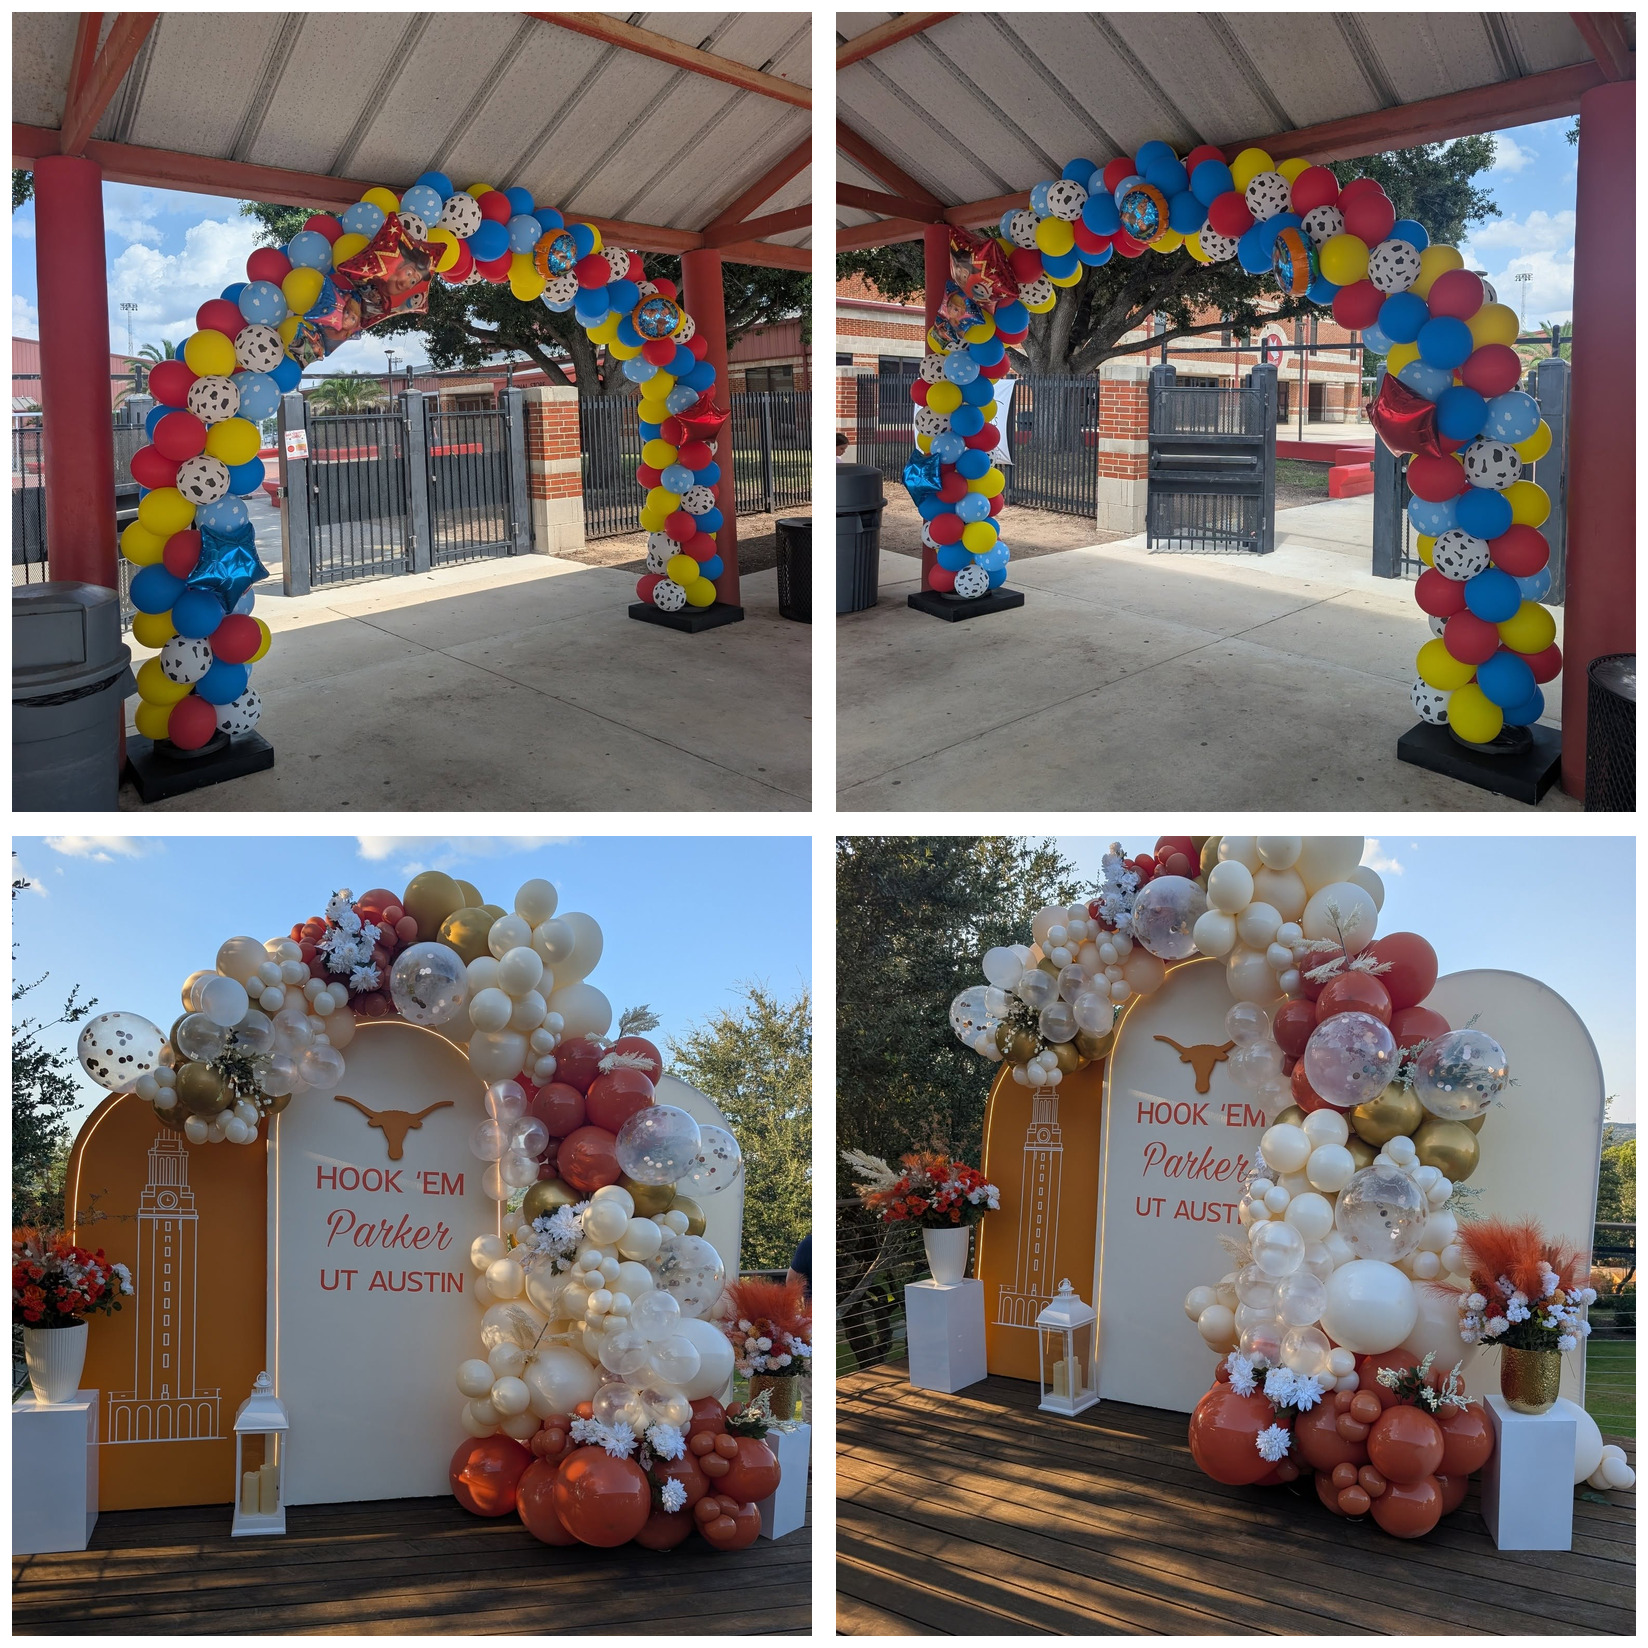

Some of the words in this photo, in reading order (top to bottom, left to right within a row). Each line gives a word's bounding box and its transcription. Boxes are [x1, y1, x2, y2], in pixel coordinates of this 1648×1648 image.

[1137, 1101, 1210, 1126] HOOK
[1221, 1103, 1266, 1127] 'EM
[1143, 1141, 1250, 1183] Parker
[316, 1166, 403, 1193] HOOK
[416, 1171, 464, 1195] 'EM
[1136, 1196, 1166, 1217] UT
[327, 1209, 452, 1250] Parker
[320, 1269, 358, 1291] UT
[368, 1270, 464, 1293] AUSTIN
